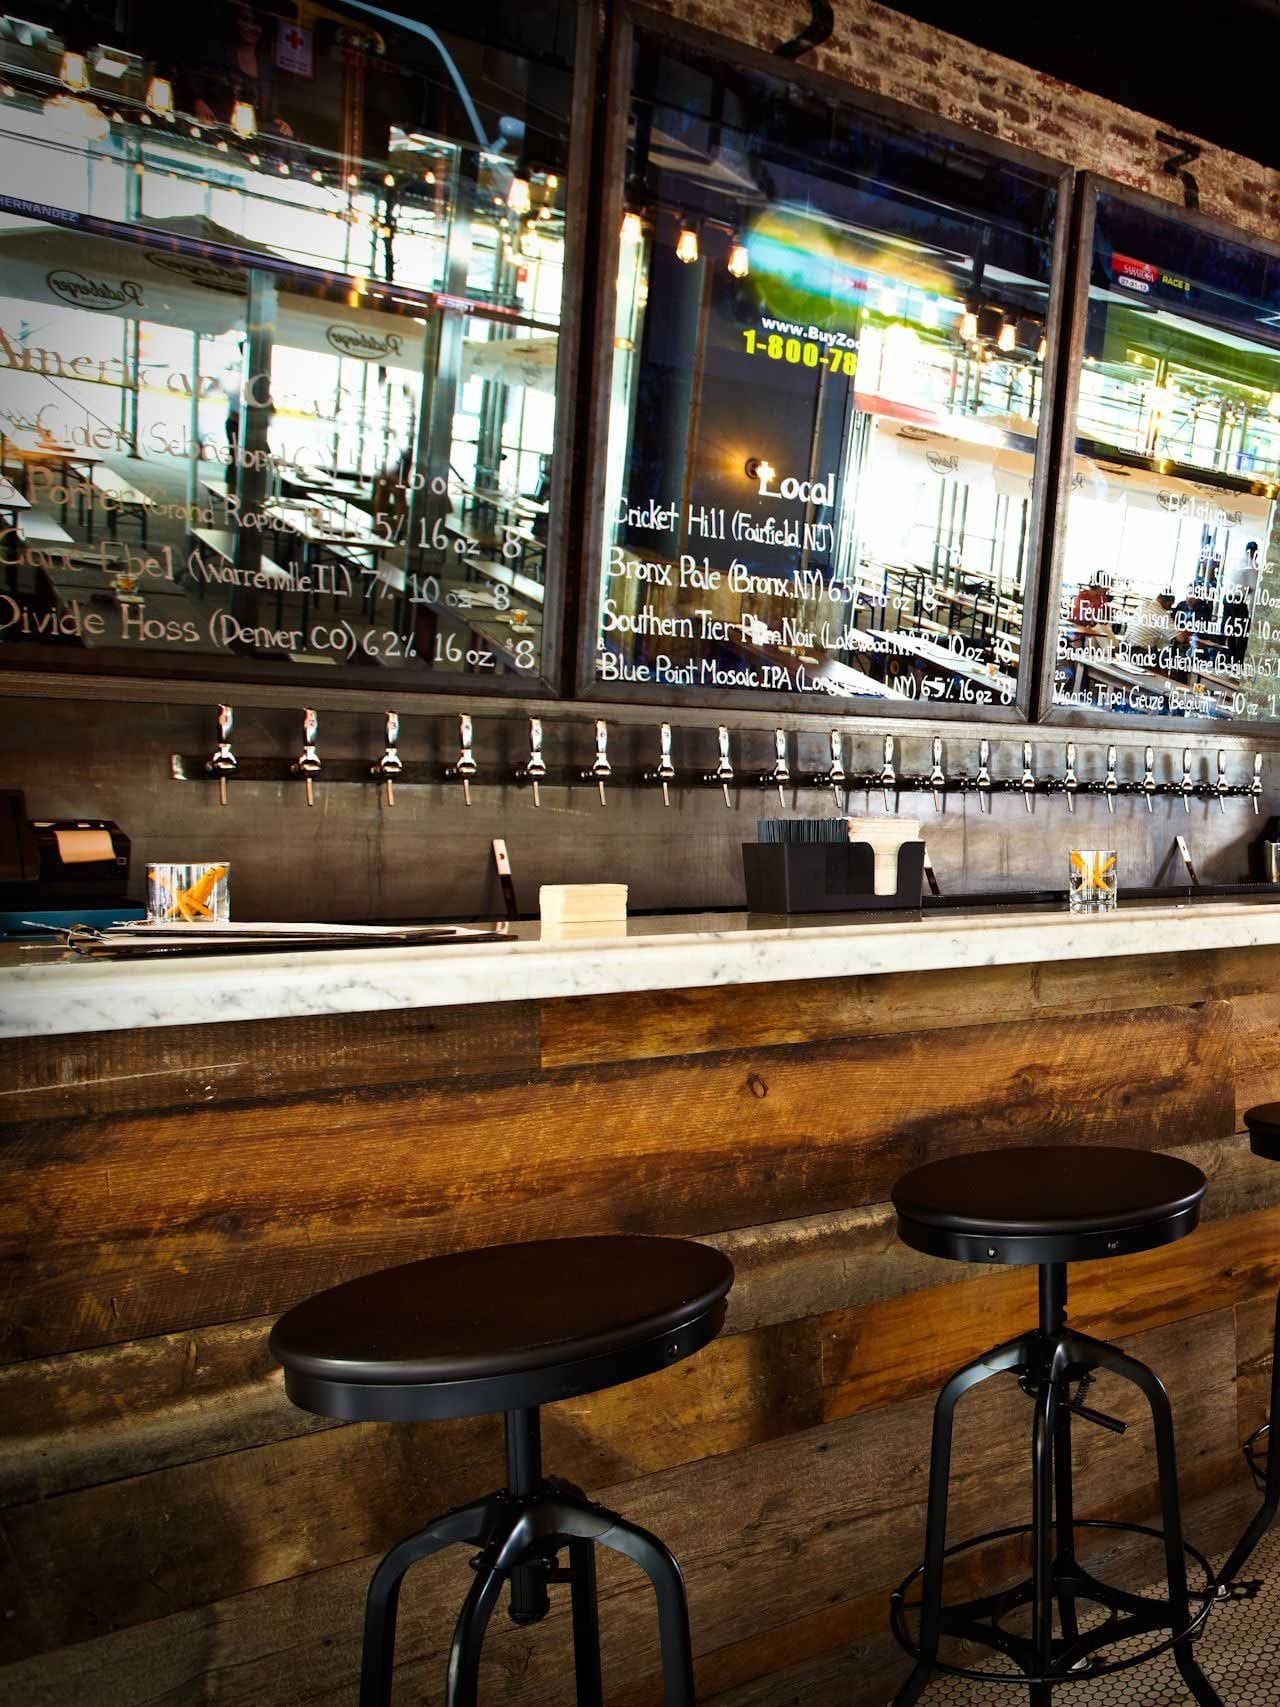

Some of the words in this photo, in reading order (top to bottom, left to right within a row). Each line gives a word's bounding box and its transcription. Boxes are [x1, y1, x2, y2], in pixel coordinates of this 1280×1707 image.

[1162, 275, 1183, 289] RACE
[743, 329, 858, 376] 1-800-78
[758, 472, 836, 508] Local
[418, 517, 449, 550] 16
[453, 538, 481, 556] oz
[611, 496, 679, 532] Cricket
[687, 503, 726, 541] Hill
[408, 573, 440, 603] 10
[606, 546, 673, 587] Bronx
[680, 554, 721, 591] Pale
[0, 594, 105, 637] Divide
[121, 603, 200, 642] Hoss
[433, 632, 462, 662] 16
[466, 649, 495, 667] oz
[601, 598, 694, 640] Southern
[695, 610, 737, 642] Tier
[782, 616, 817, 648] Noir
[966, 646, 985, 663] oz
[1256, 620, 1271, 641] 10
[1119, 641, 1157, 668] Blonde
[600, 651, 652, 683] Blue
[655, 654, 700, 686] Point
[700, 658, 760, 689] Mosaic
[761, 665, 793, 691] IPA
[958, 679, 975, 701] 16
[975, 687, 994, 705] oz
[1129, 685, 1165, 711] Geuze
[1230, 692, 1246, 715] 10
